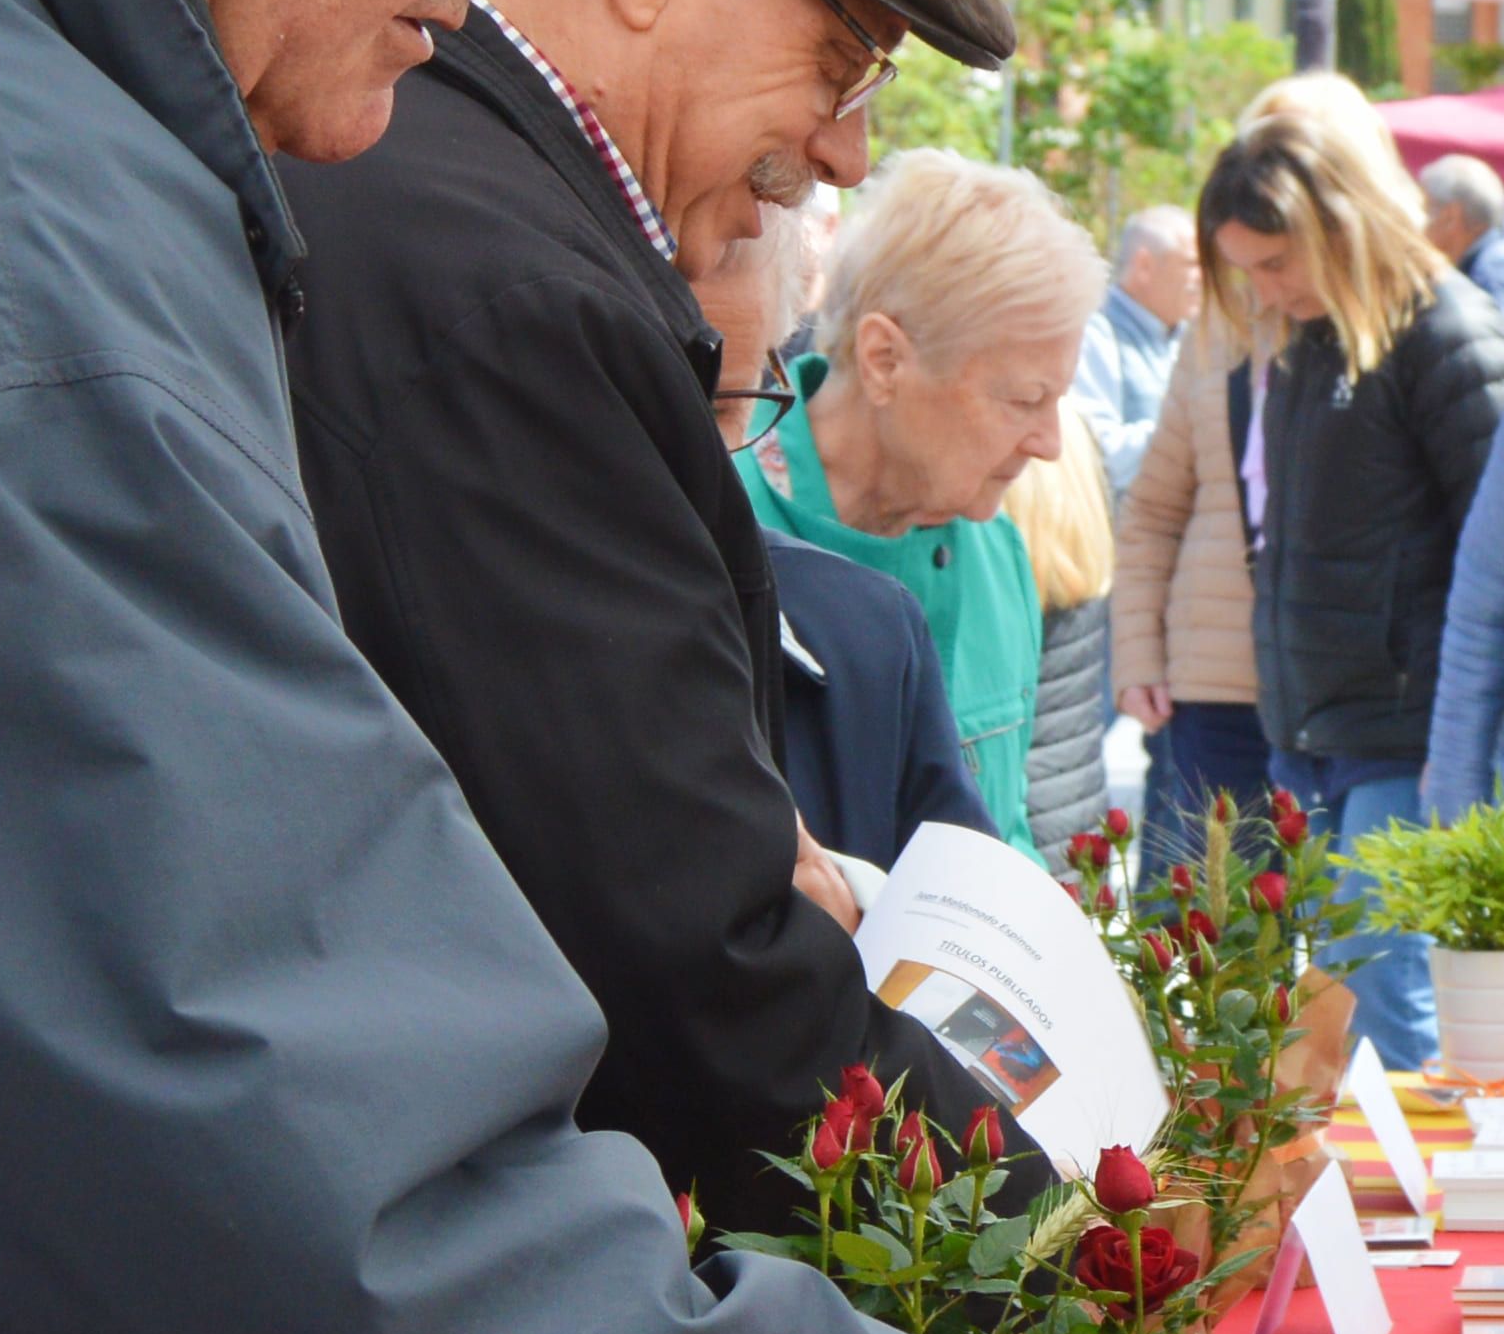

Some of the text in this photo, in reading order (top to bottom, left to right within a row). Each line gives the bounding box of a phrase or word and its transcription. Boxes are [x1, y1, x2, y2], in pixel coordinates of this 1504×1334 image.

[941, 895, 998, 926] Maldonado
[938, 938, 988, 969] TÍTULOS
[989, 965, 1054, 1031] PUBLICADOS
